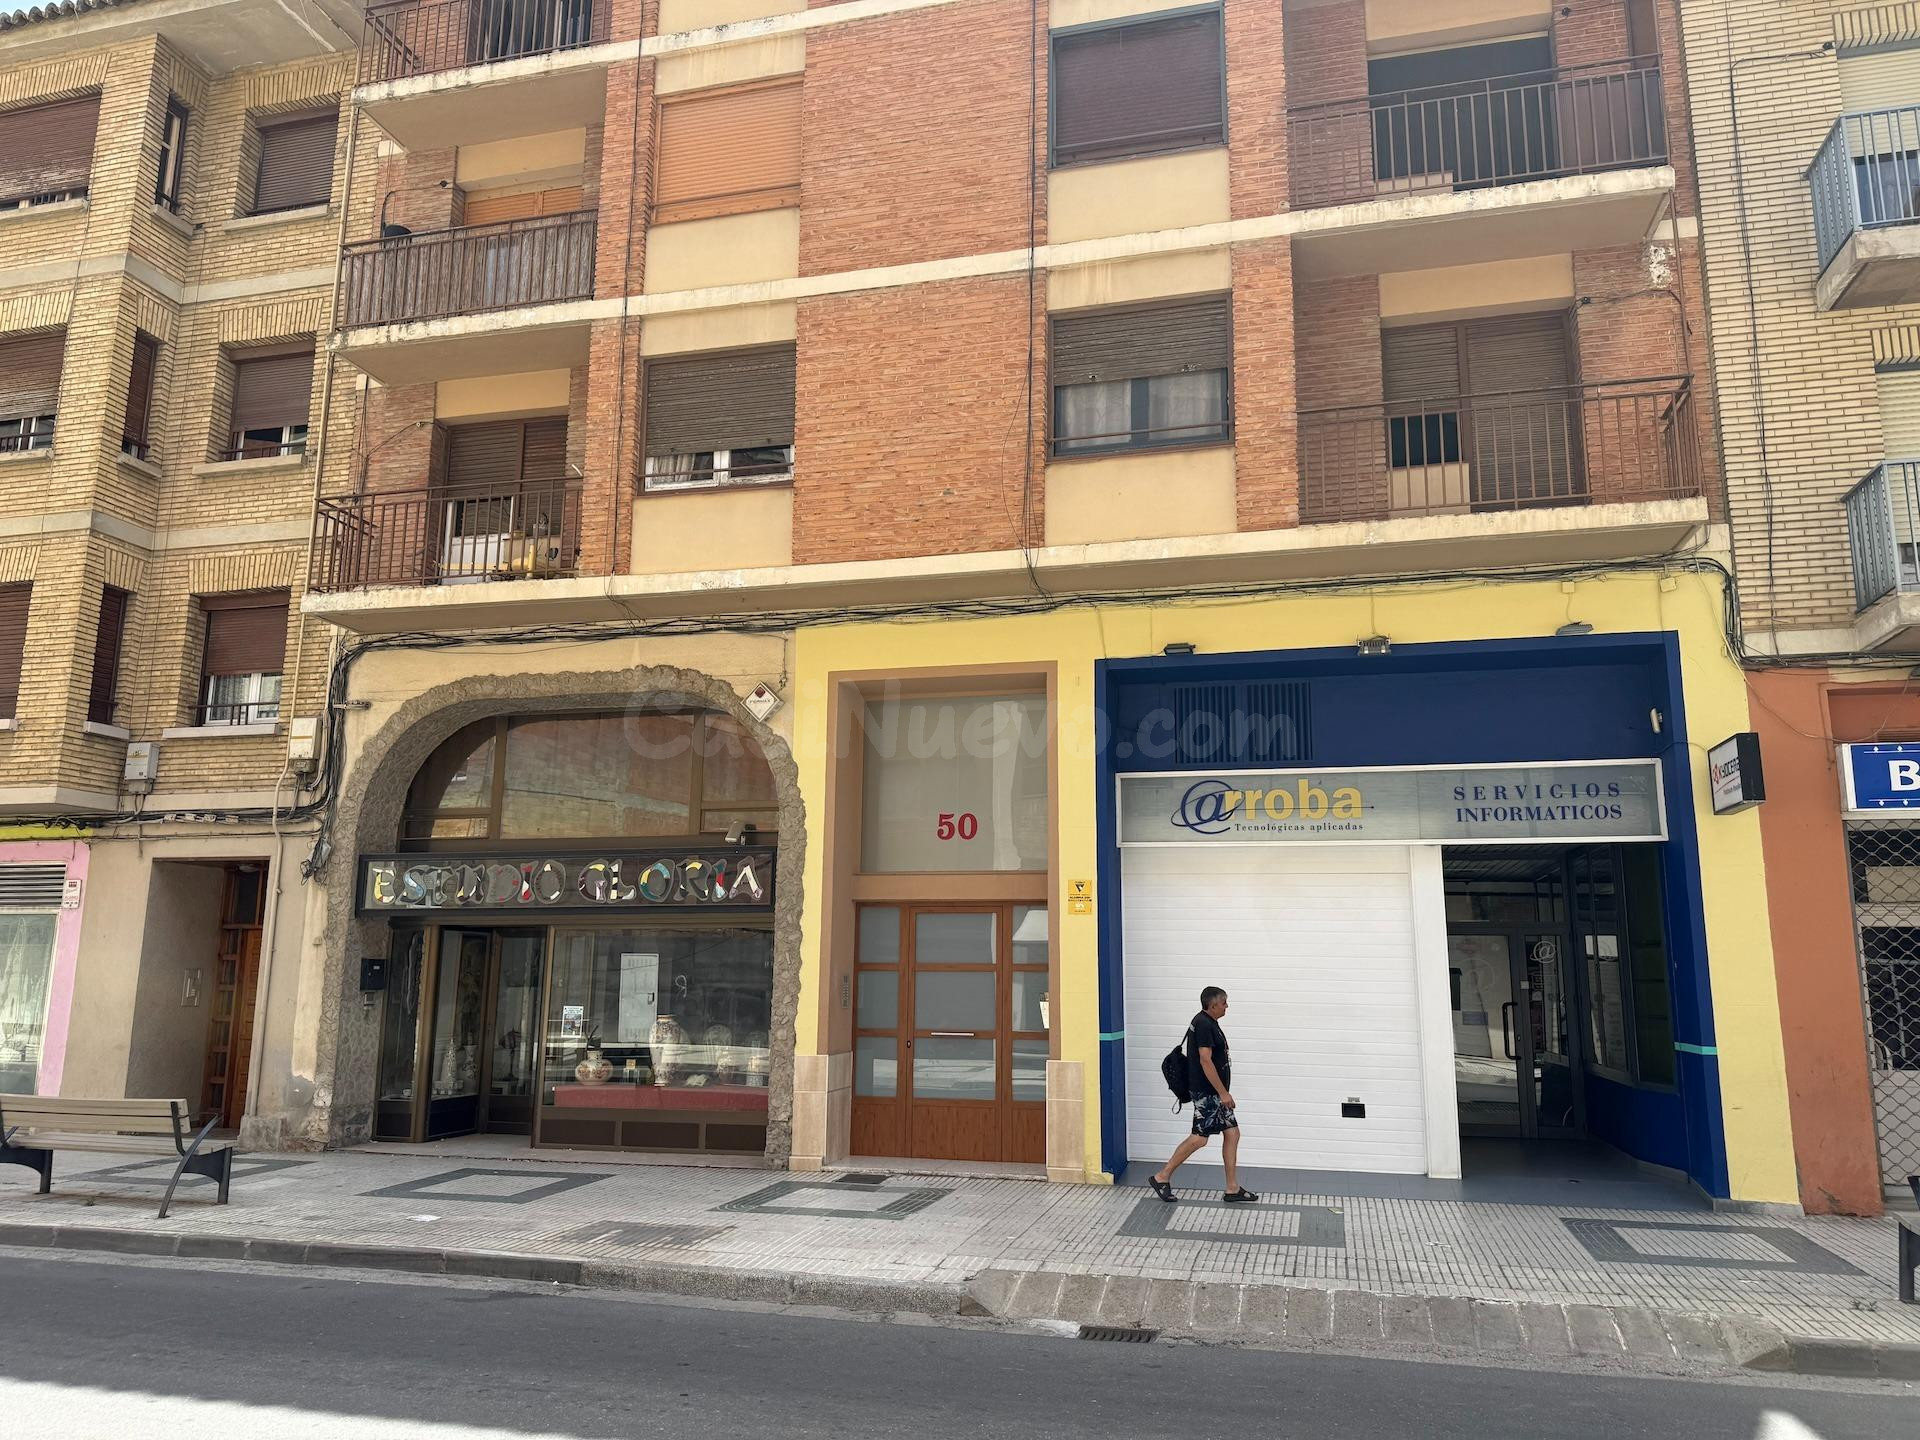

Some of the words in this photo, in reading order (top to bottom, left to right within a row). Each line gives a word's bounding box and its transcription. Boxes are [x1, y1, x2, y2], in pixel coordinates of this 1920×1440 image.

[1453, 782, 1620, 801] SERVICIOS
[1456, 804, 1622, 823] INFORMATICOS
[937, 813, 978, 840] 50
[1234, 823, 1305, 833] Tecnológicas
[1310, 822, 1364, 833] aplicadas
[372, 861, 566, 904] ESTUDIO
[578, 855, 763, 903] GLORIA
